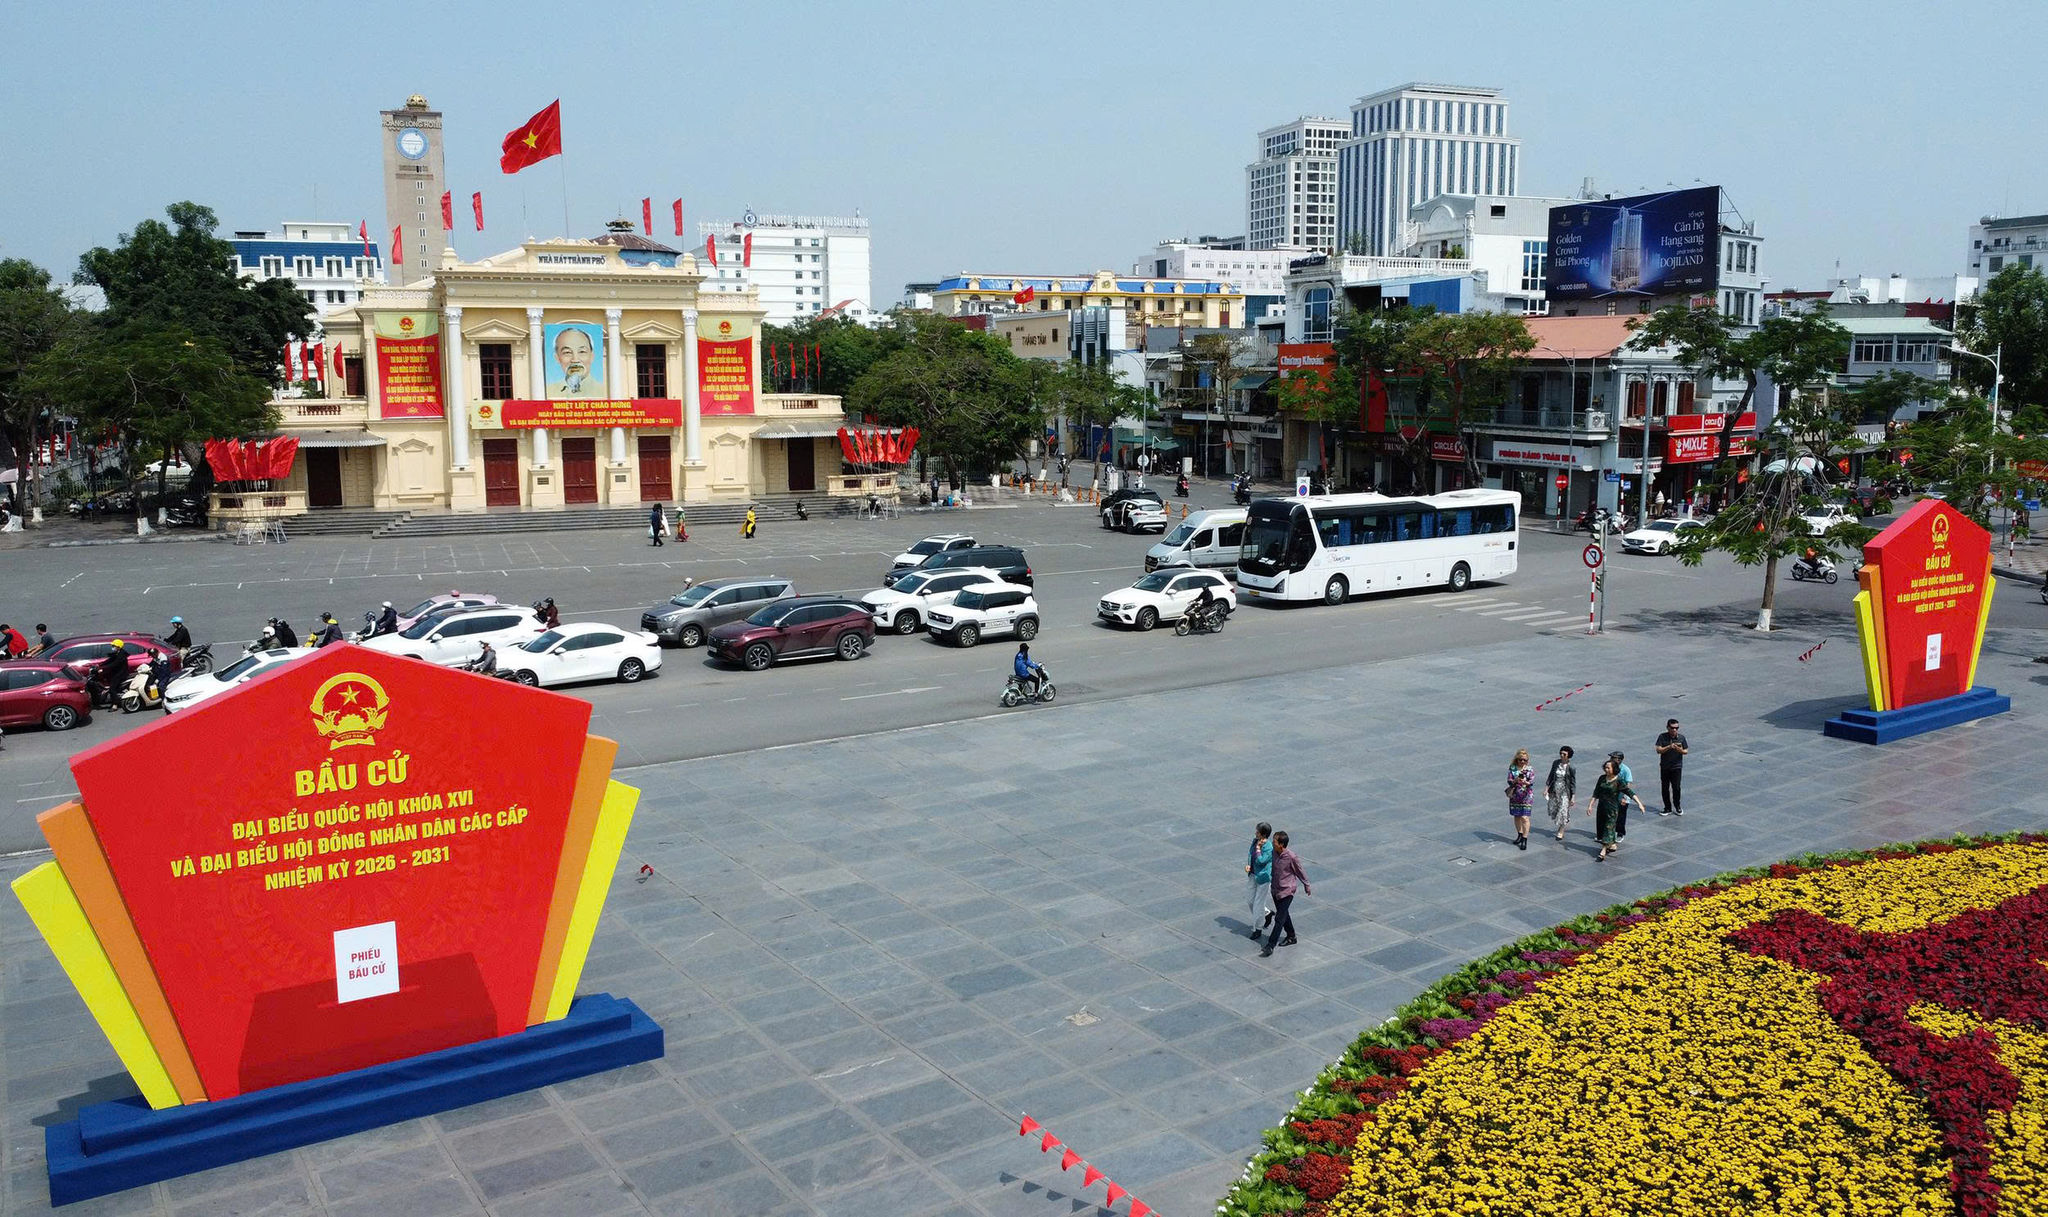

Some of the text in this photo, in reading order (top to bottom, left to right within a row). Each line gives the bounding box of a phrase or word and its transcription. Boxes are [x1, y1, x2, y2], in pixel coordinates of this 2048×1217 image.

[1674, 220, 1704, 232] Căn hộ
[1556, 233, 1582, 244] Golden
[1660, 234, 1704, 248] Hạng sang
[1556, 246, 1579, 256] Crown
[538, 254, 606, 265] NHÀ HÁT THÀNH PHỐ
[1660, 254, 1704, 270] DOJILAND
[553, 401, 632, 410] NHIỆT LIỆT CHÀO MỪNG
[1434, 442, 1454, 452] CIRCLE
[1682, 436, 1708, 452] MIXUE
[1926, 552, 1951, 570] BẦU CỬ
[295, 750, 410, 796] BẦU CỬ
[232, 790, 474, 841] ĐẠI BIỂU QUỐC HỘI KHÓA XVI
[170, 803, 528, 878] VÀ ĐẠI BIỂU HỘI ĐỒNG NHÂN DÂN CÁC CẤP
[265, 866, 324, 891] NHIỆM
[328, 858, 350, 881] KỲ
[355, 857, 396, 877] 2026
[412, 846, 450, 868] 2031
[350, 946, 381, 964] PHIẾU
[348, 961, 387, 980] BẦU CỬ
